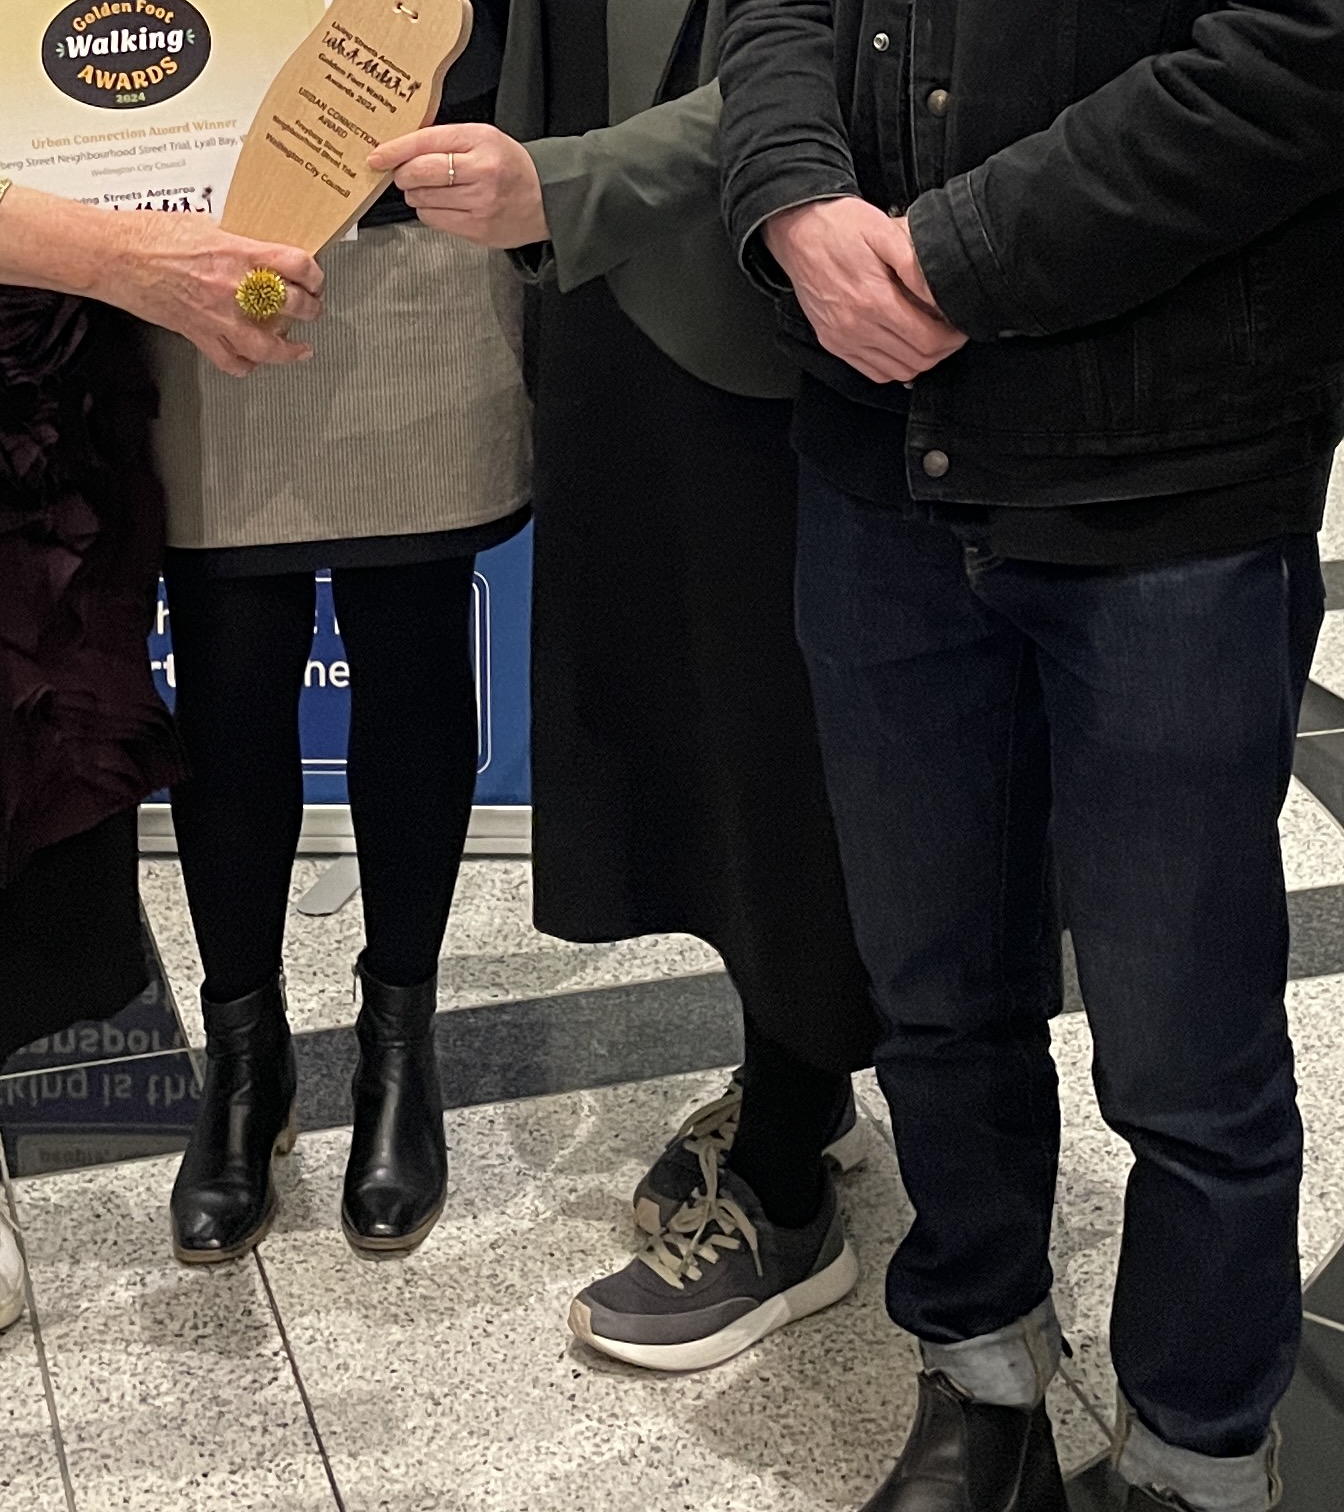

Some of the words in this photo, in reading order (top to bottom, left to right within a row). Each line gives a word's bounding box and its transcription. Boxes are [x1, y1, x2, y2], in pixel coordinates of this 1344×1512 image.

[72, 0, 132, 32] Golden
[65, 26, 184, 59] Walking
[77, 56, 179, 91] AWARDS
[318, 53, 346, 76] Golden
[366, 86, 397, 114] Walking
[115, 92, 146, 104] 2024
[325, 74, 355, 98] Awards
[355, 95, 377, 113] 2024
[298, 86, 327, 112] URBAN
[327, 108, 381, 149] CONNECTION
[318, 115, 348, 139] AWARD
[31, 136, 71, 150] Urban
[73, 128, 147, 145] Connection
[148, 121, 190, 136] Award
[191, 118, 238, 131] Winner
[25, 155, 56, 168] Street
[57, 146, 136, 166] Neighbourhood
[138, 142, 167, 156] Street
[265, 133, 304, 166] Wellington
[304, 162, 320, 178] City
[321, 174, 352, 199] Council
[103, 190, 142, 203] Streets
[146, 186, 196, 198] Aotearoa
